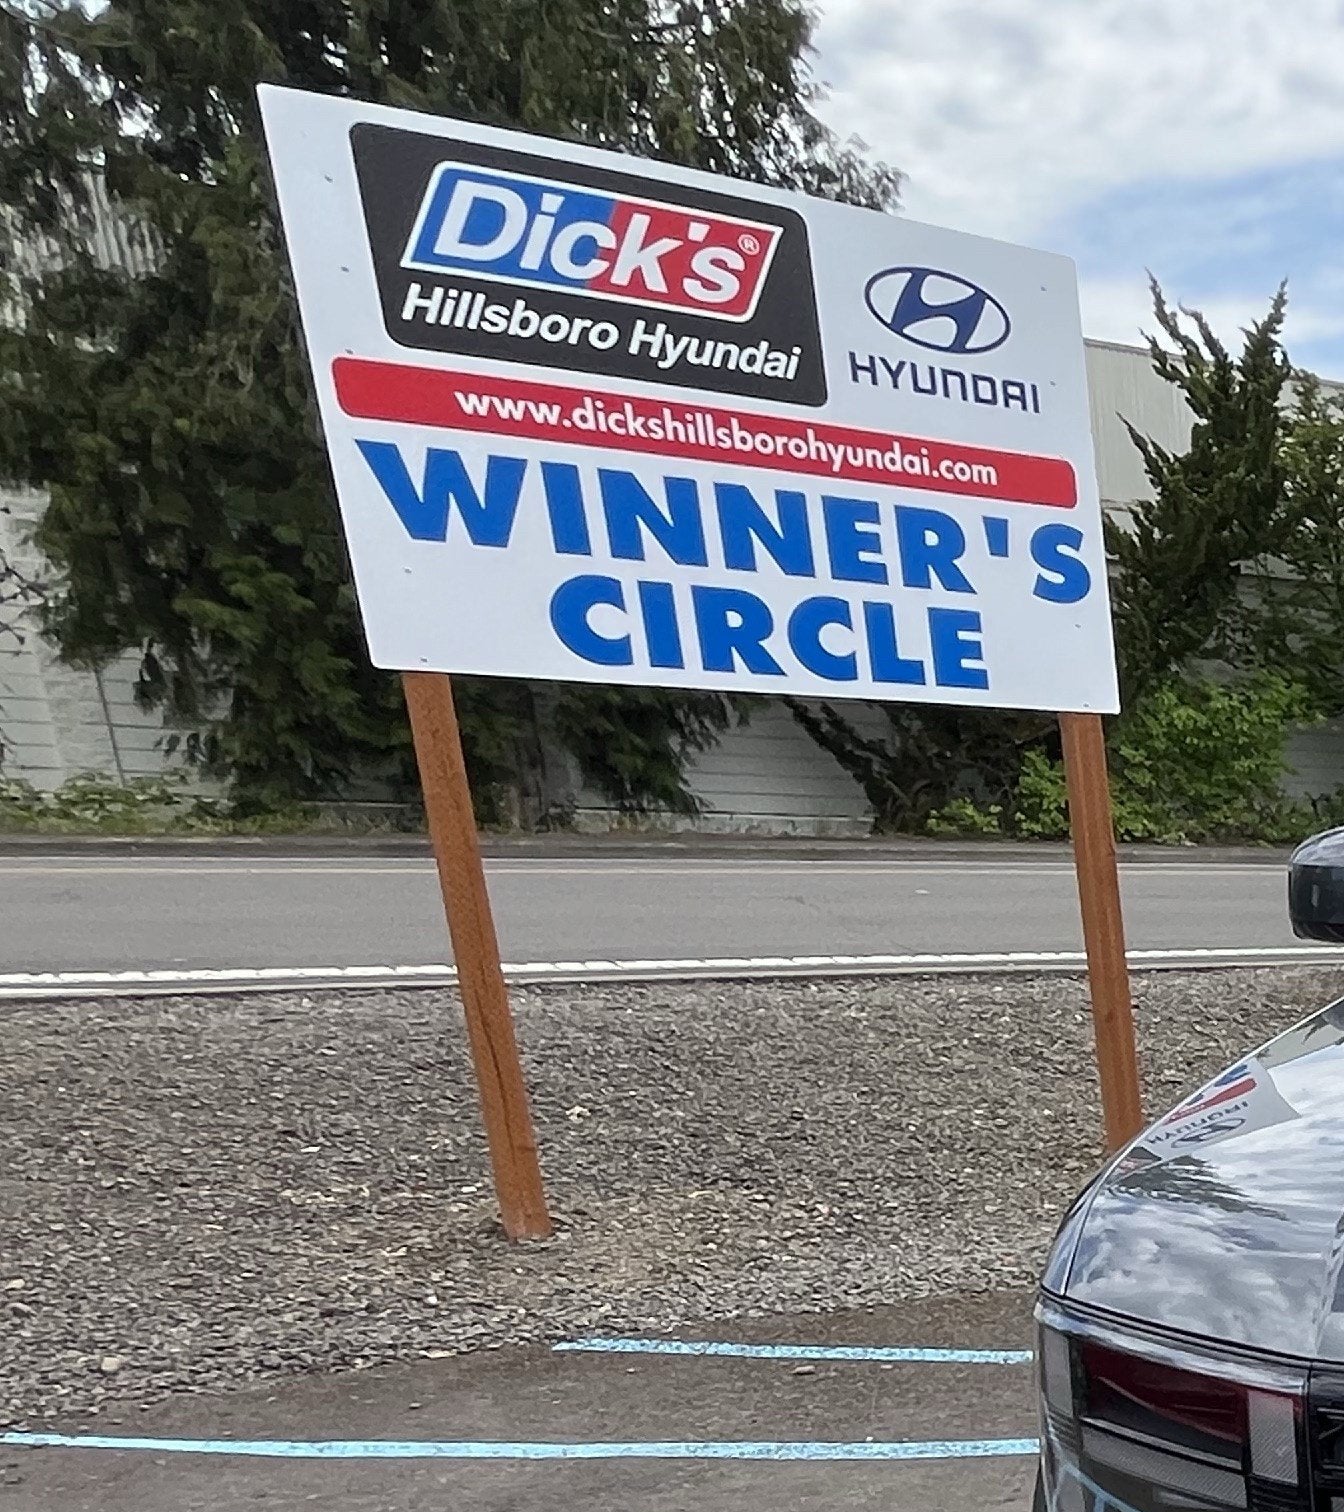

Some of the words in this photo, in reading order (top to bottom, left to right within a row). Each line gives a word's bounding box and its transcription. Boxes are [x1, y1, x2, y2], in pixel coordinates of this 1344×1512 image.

[401, 282, 618, 351] Hillsboro
[628, 317, 803, 381] Hyundai
[848, 351, 1042, 415] HYUNDAI
[454, 390, 999, 487] www.dickshillsborohyundai.com
[354, 438, 1093, 604] WINNER'S
[549, 573, 990, 691] CIRCLE
